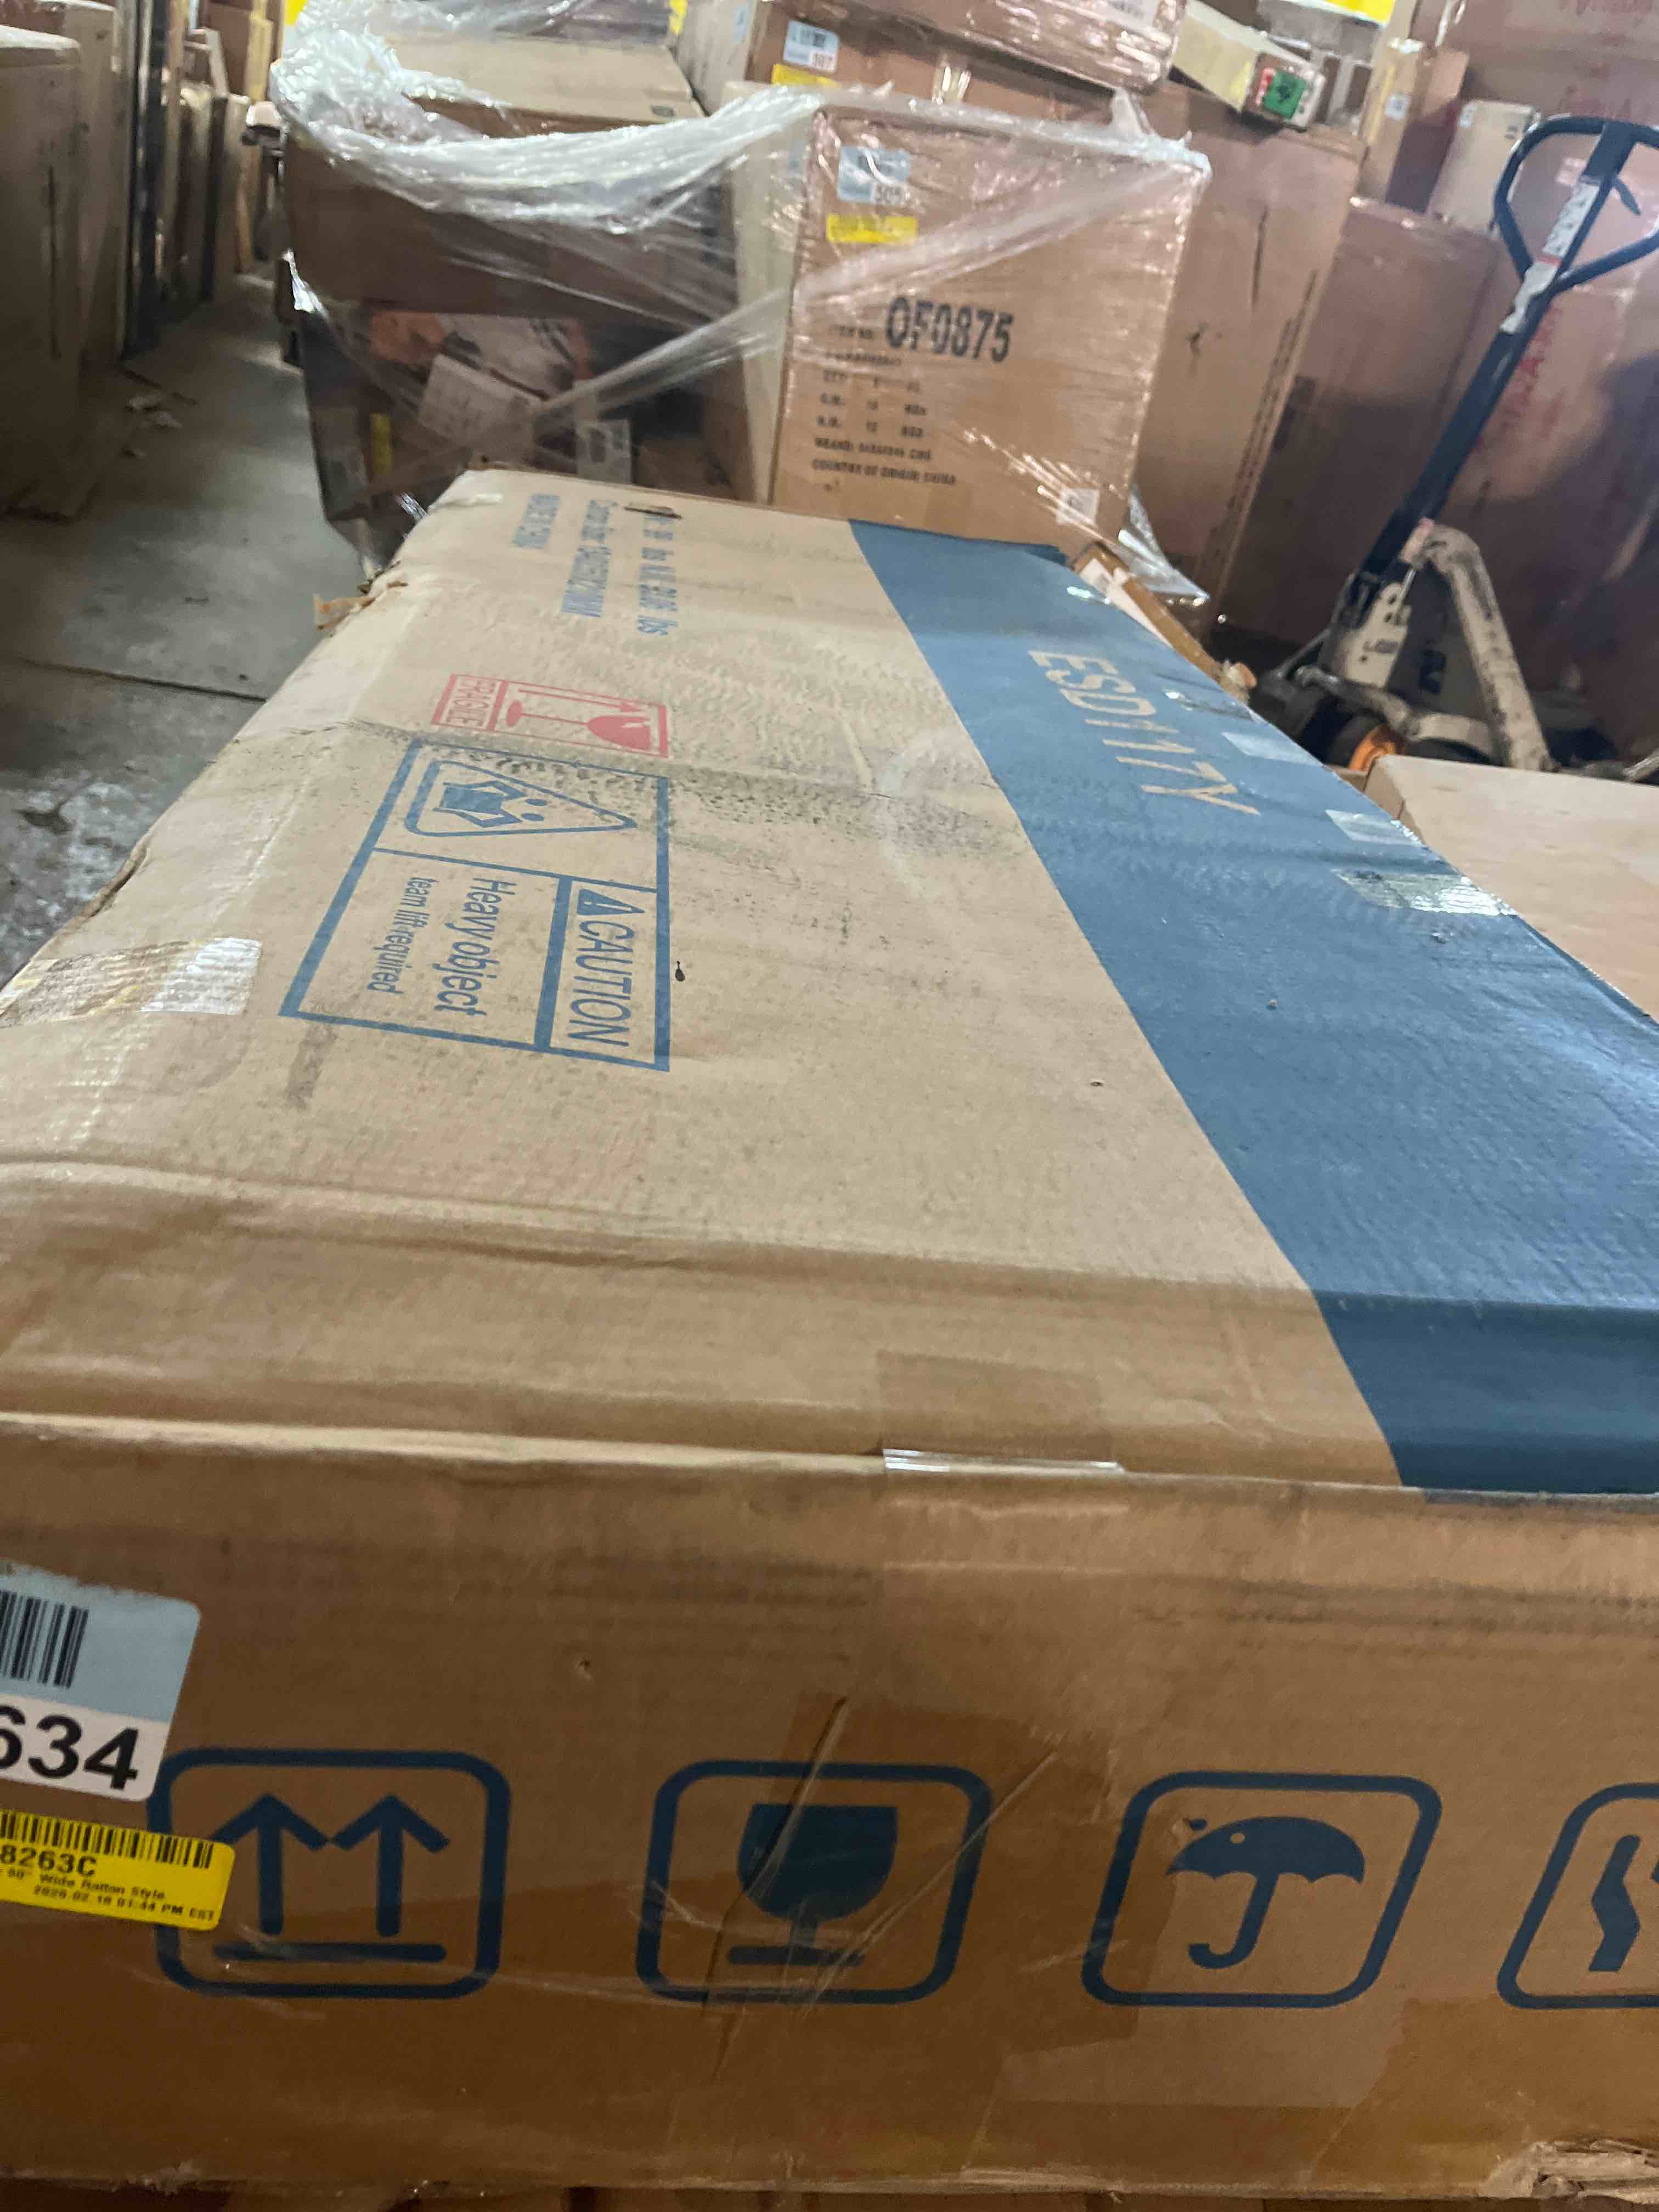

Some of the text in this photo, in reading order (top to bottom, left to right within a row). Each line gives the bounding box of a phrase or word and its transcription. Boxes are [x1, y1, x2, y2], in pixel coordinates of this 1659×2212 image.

[366, 877, 439, 994] team lift required
[432, 878, 517, 1017] Heavy object
[568, 920, 636, 1047] CAUTION
[162, 1904, 184, 1916] PM
